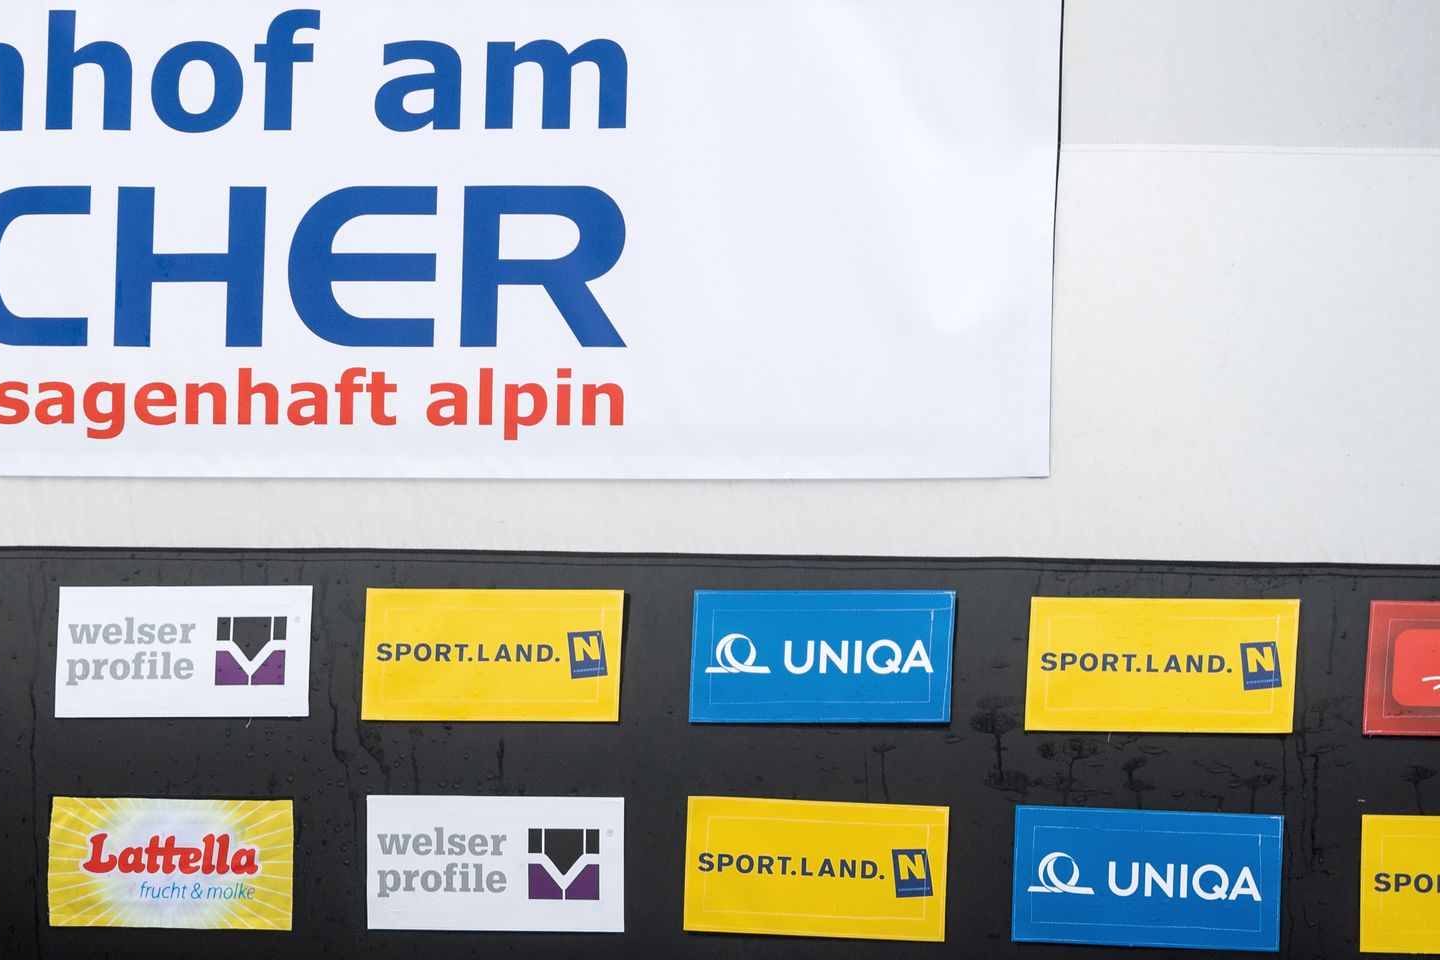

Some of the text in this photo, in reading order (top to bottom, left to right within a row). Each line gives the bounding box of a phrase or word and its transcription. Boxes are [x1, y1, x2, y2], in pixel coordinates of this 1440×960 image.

[373, 38, 630, 131] am
[426, 370, 626, 441] alpin
[68, 616, 196, 645] welser
[66, 651, 194, 687] profile
[375, 642, 561, 664] SPORT.LAND.
[783, 639, 934, 676] UNIQA
[1040, 652, 1233, 675] SPORT.LAND.
[82, 833, 259, 876] Lattella
[376, 827, 508, 857] welser
[376, 863, 508, 898] profile
[697, 853, 885, 881] SPORT.LAND.
[1108, 861, 1262, 902] UNIQA
[138, 880, 256, 902] frucht & molke
